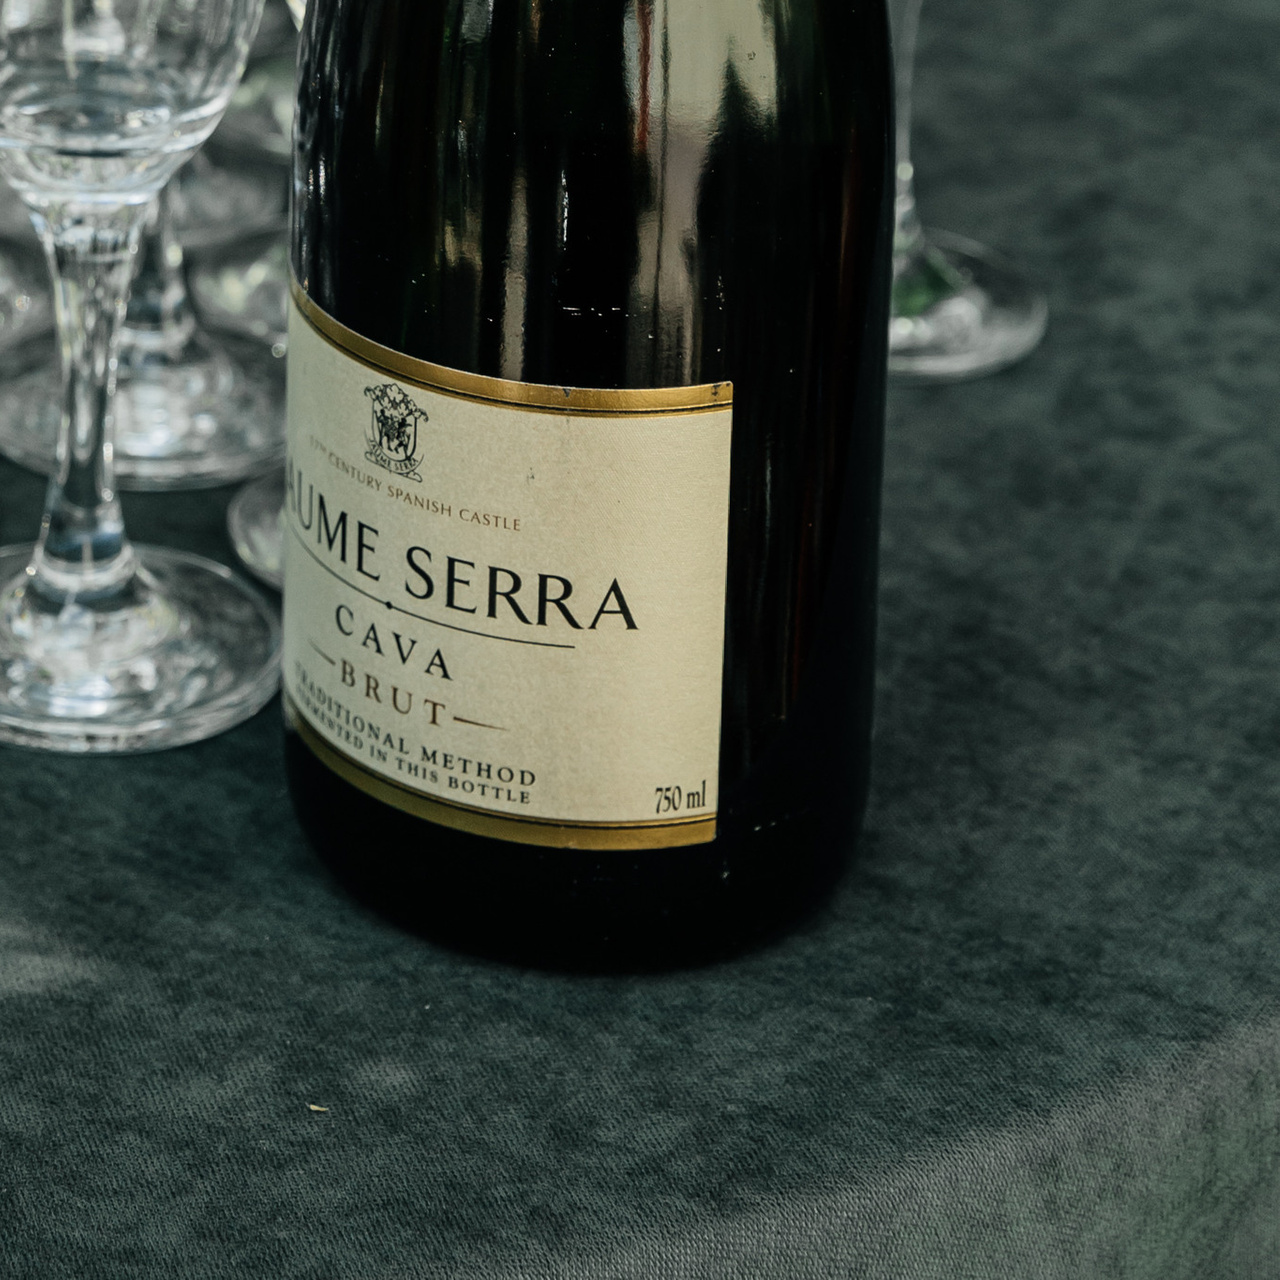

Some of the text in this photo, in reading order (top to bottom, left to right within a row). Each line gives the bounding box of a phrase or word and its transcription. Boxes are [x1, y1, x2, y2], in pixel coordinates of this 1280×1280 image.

[328, 451, 381, 491] CENTURY
[387, 484, 453, 518] SPANISH
[459, 508, 522, 532] CASTLE
[286, 456, 640, 631] AUME SERRA
[335, 604, 454, 681] CAVA
[340, 658, 447, 727] BRUT
[369, 745, 388, 765] IN
[395, 756, 439, 783] THIS
[447, 775, 532, 805] BOTTLE
[420, 744, 537, 787] METHOD
[655, 779, 706, 814] 750 ml
